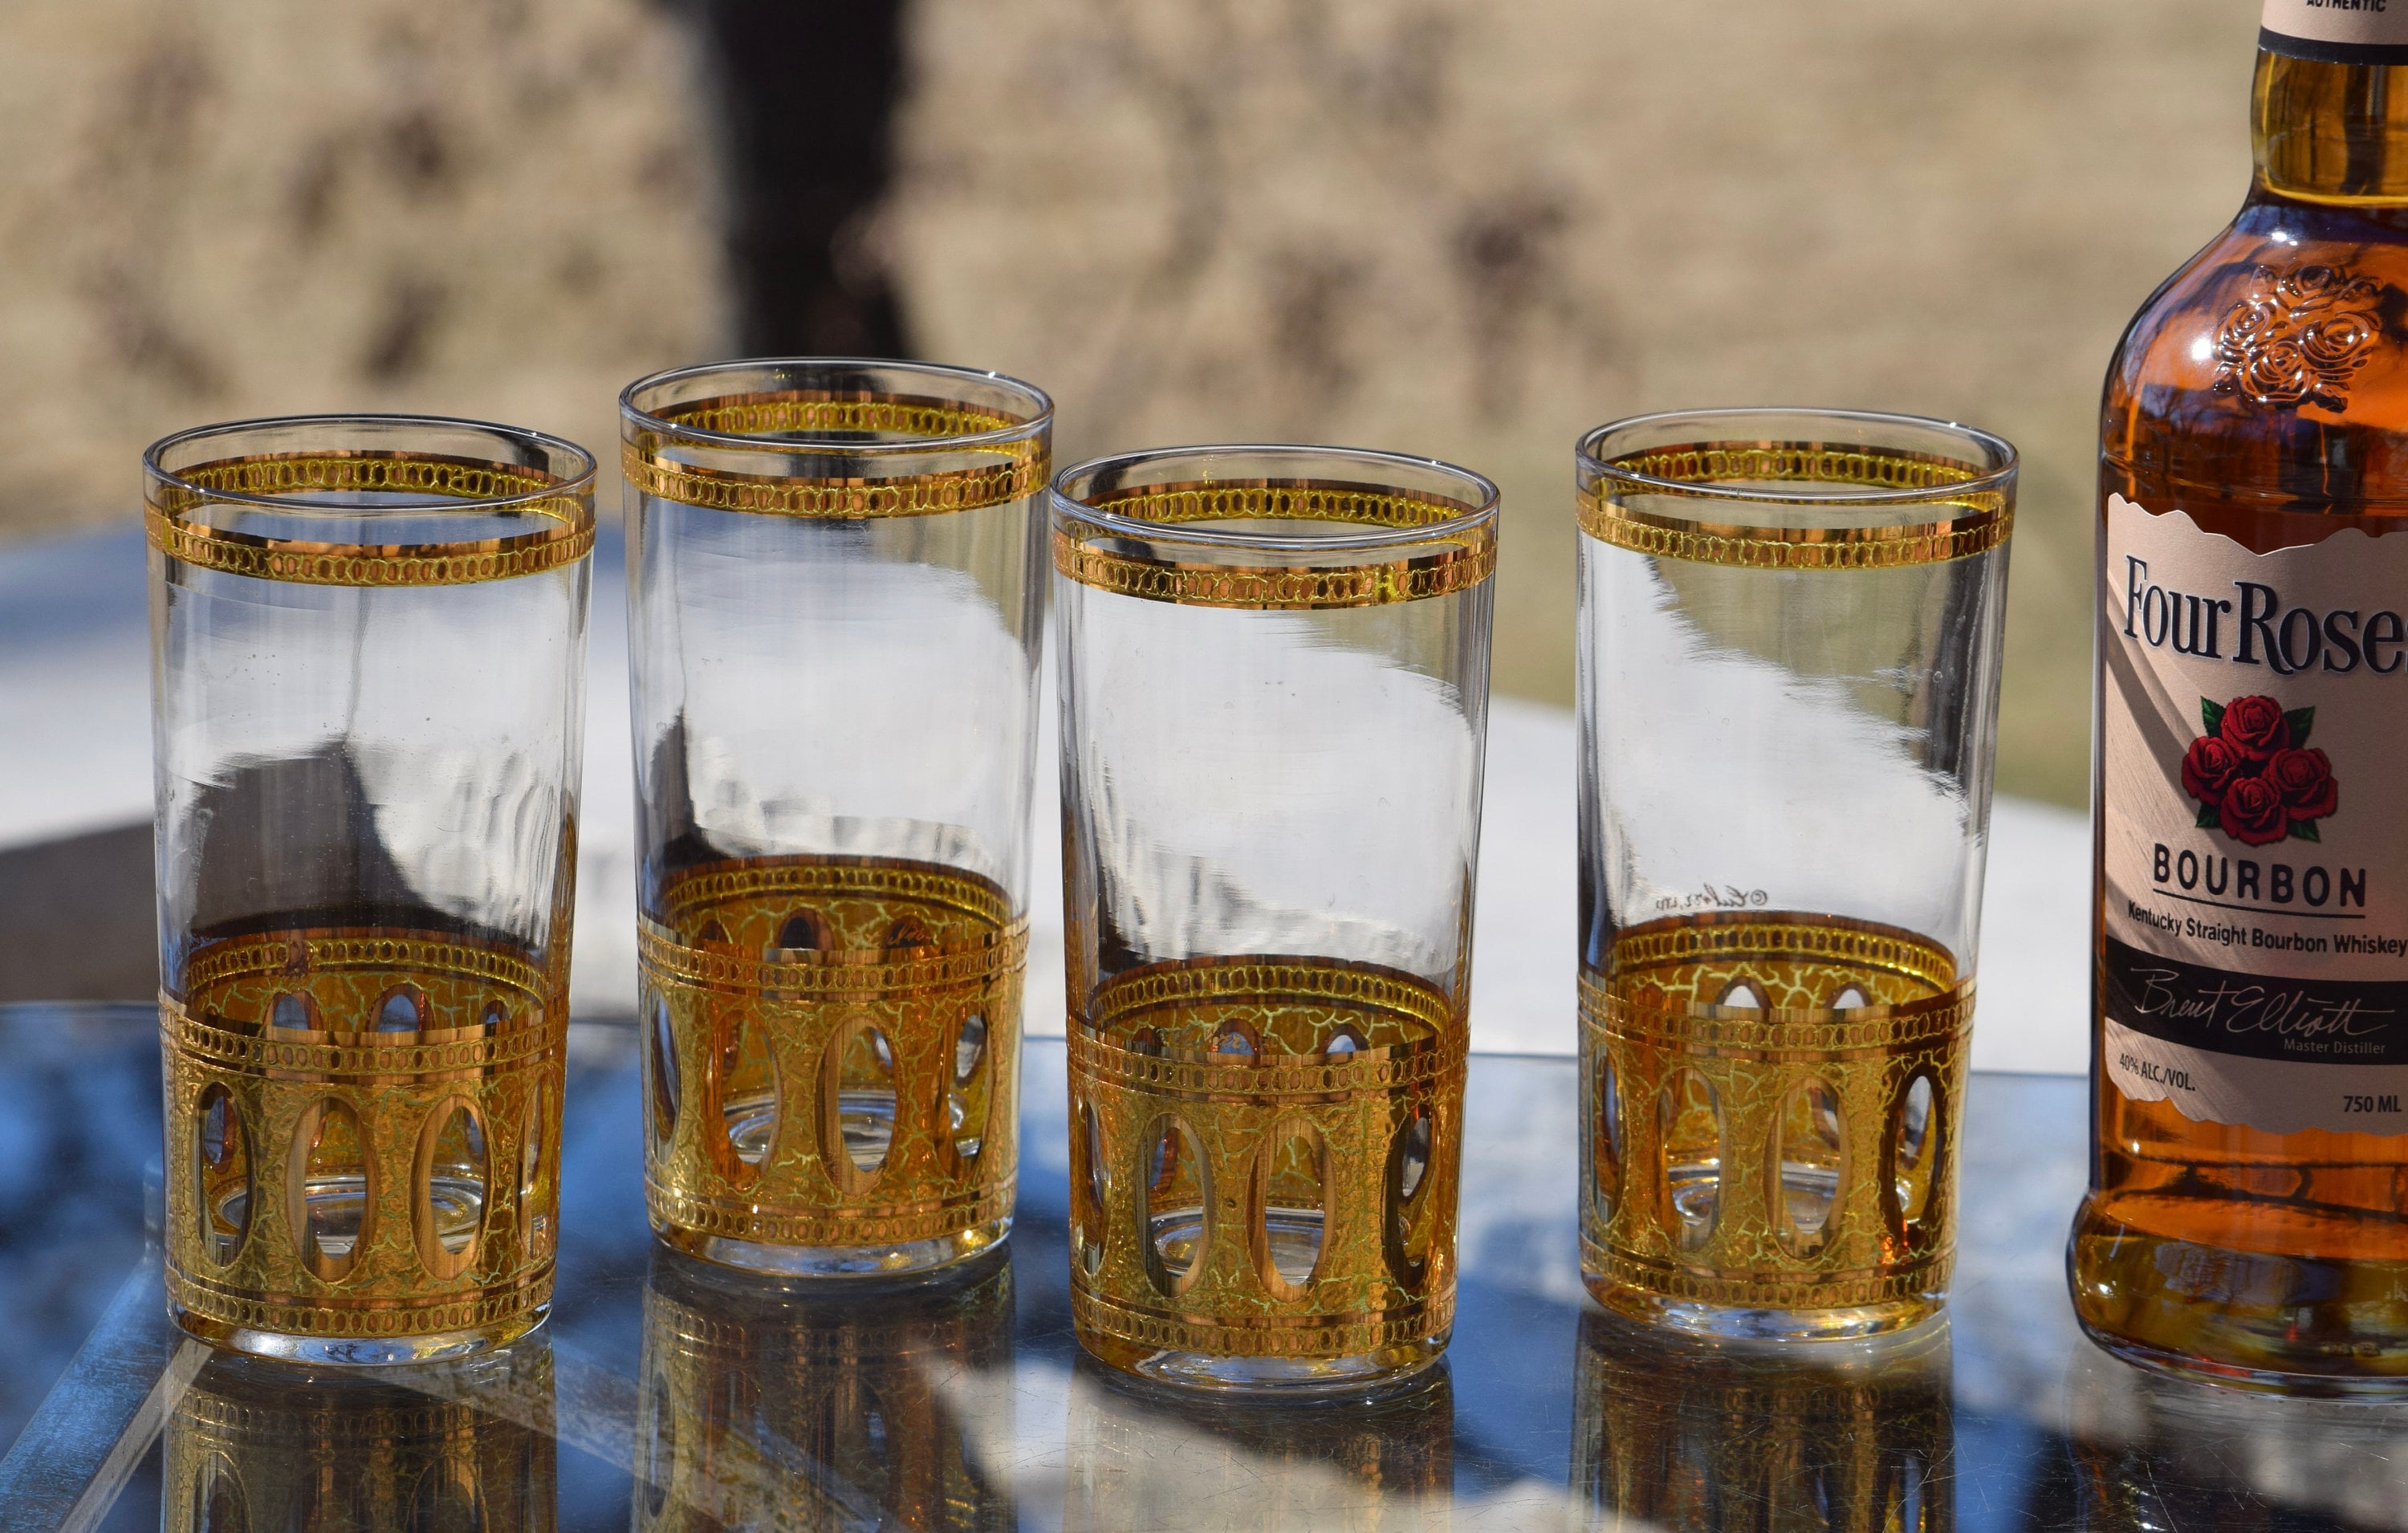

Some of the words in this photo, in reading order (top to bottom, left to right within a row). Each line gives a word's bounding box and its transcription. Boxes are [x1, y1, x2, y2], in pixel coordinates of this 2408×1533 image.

[2124, 554, 2231, 660] Four
[2232, 580, 2408, 676] Rose
[2153, 842, 2367, 908] BOURBON
[2128, 899, 2182, 937] Kentucky
[2186, 917, 2247, 946] Straight
[2251, 928, 2328, 953] Bourbon
[2333, 934, 2408, 958] Whiskey
[2283, 1038, 2330, 1053] Master
[2333, 1040, 2386, 1055] Distiller
[2120, 1053, 2139, 1075] 40%
[2141, 1061, 2196, 1092] ALC./VOL.
[2343, 1095, 2373, 1112] 750
[2377, 1096, 2402, 1113] ML
